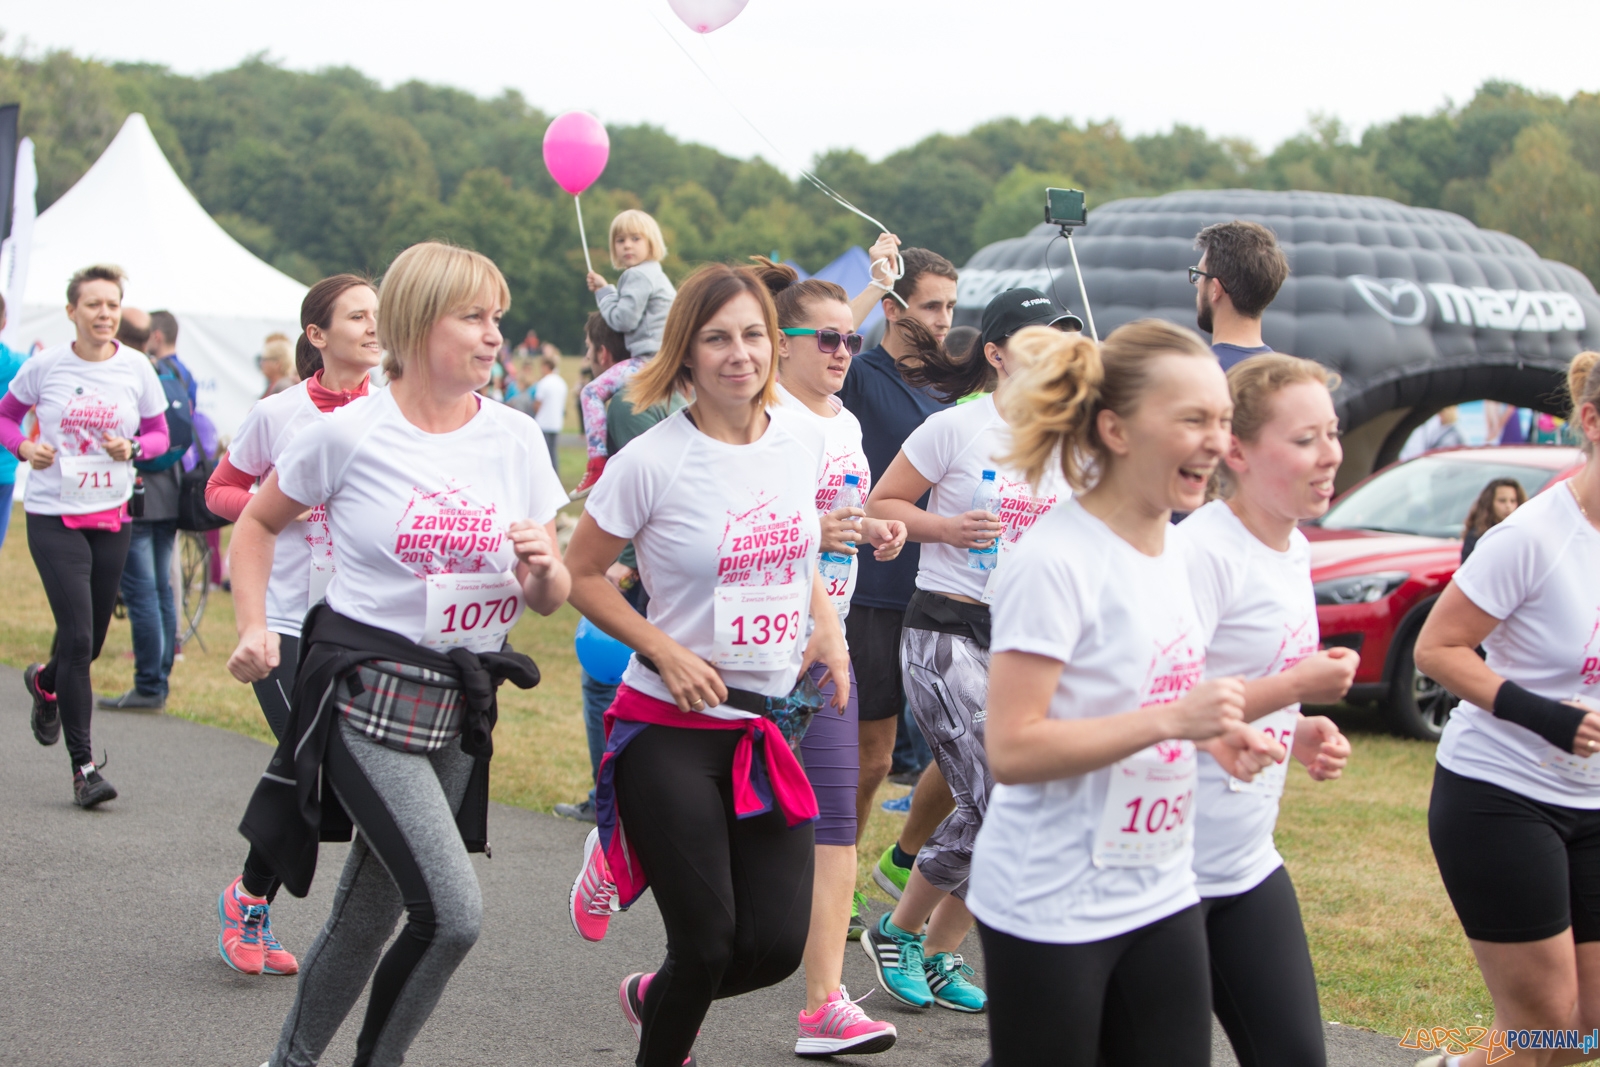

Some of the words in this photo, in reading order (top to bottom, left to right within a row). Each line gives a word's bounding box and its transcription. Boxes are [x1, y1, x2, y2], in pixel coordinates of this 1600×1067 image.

[69, 408, 115, 420] zawsze
[77, 471, 113, 488] 711
[827, 474, 868, 490] zaze
[439, 508, 456, 516] BIEG
[457, 509, 482, 517] KOBIET
[1001, 497, 1052, 516] zawsze
[411, 514, 492, 533] zawsze
[752, 525, 767, 534] BIEG
[767, 521, 790, 531] KOBIET
[394, 532, 502, 557] pier(w)si!
[732, 526, 800, 553] zawsze
[717, 539, 809, 577] pier(w)si!
[721, 570, 751, 584] 2016
[440, 595, 518, 634] 1070
[731, 610, 800, 646] 1393
